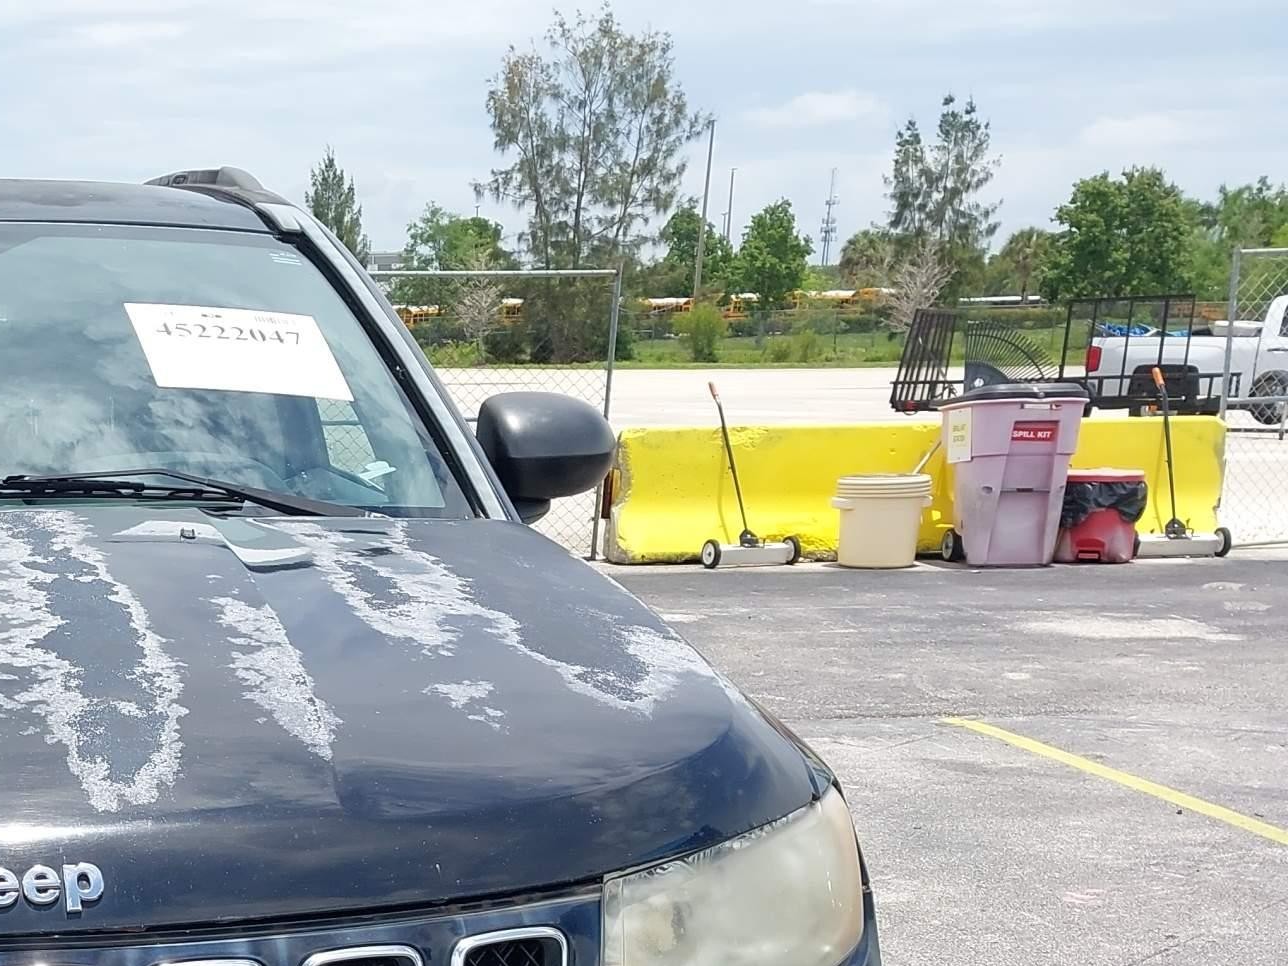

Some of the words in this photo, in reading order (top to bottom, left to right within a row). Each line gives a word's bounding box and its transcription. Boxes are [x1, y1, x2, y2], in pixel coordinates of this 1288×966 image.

[155, 321, 301, 346] 45222047
[1012, 430, 1035, 438] SPILL
[1036, 430, 1052, 438] KIT
